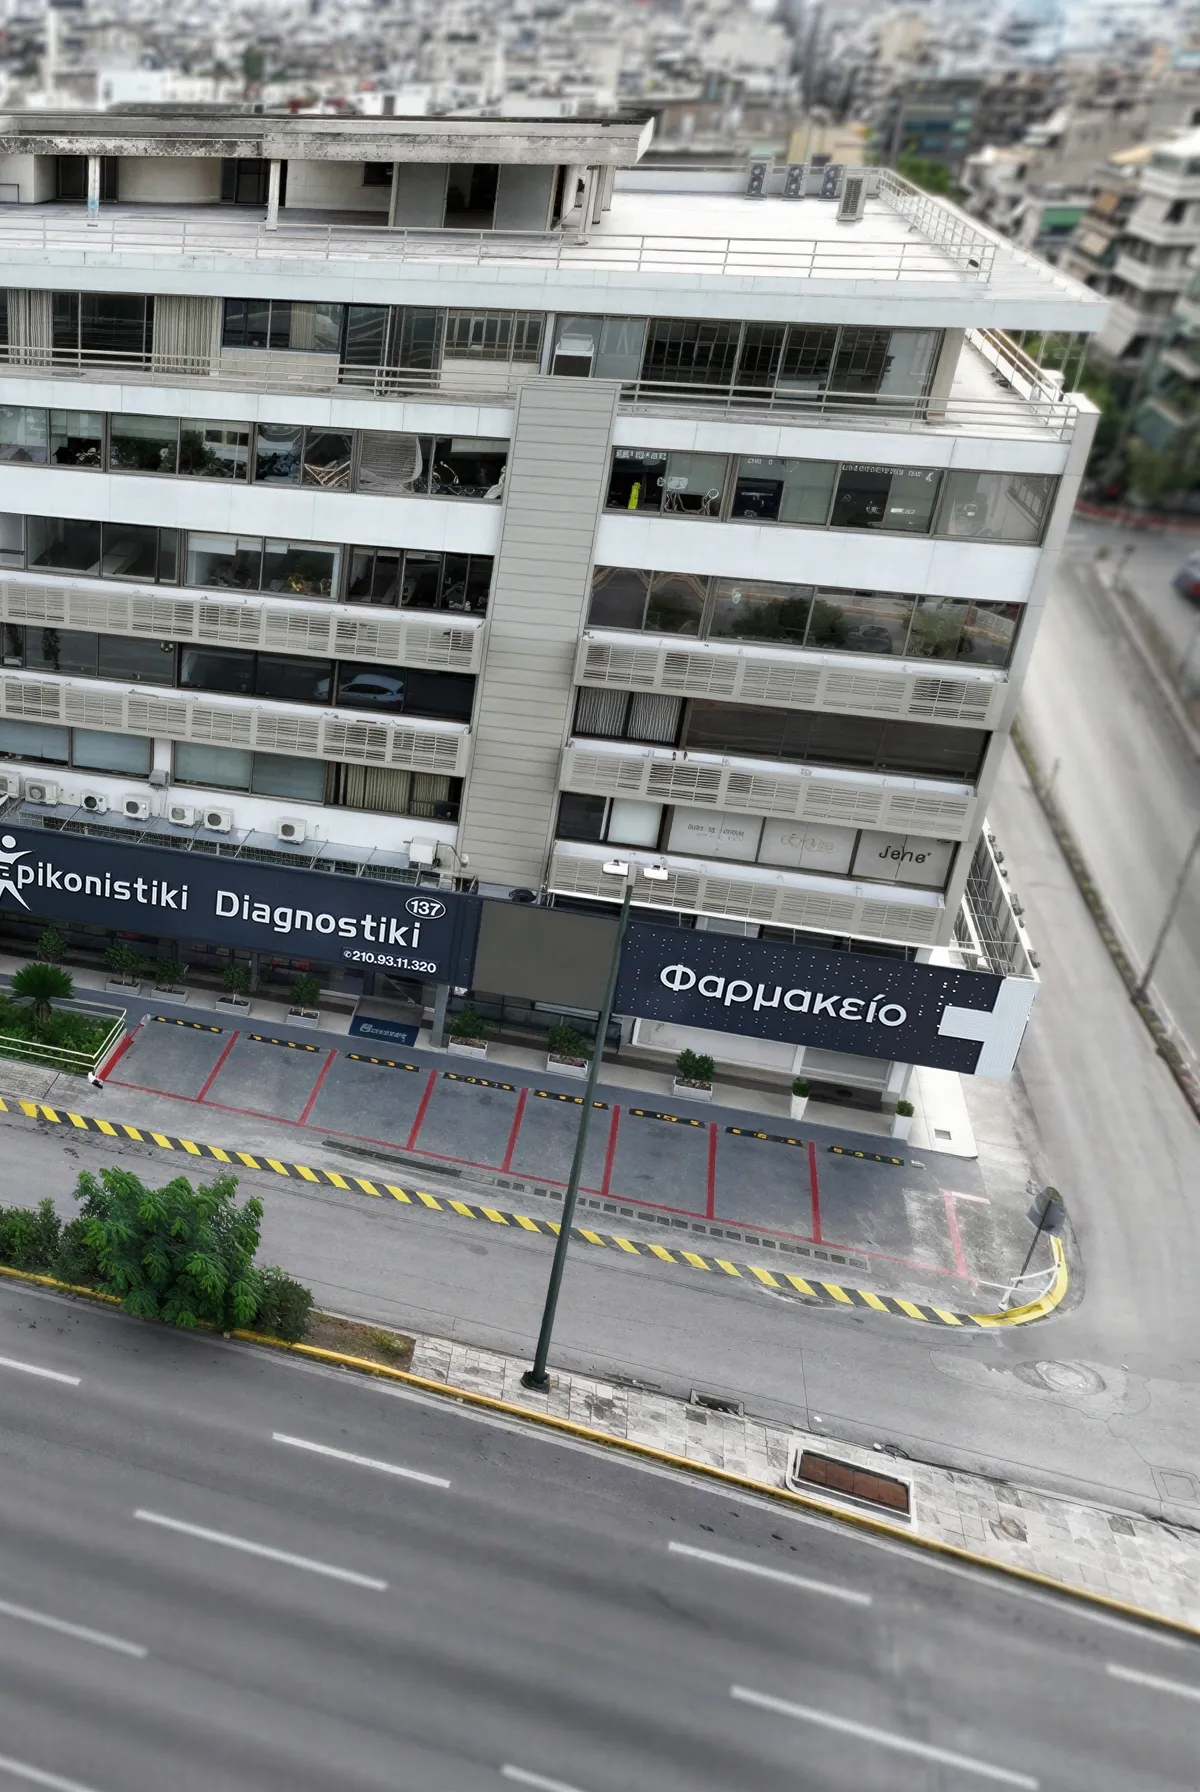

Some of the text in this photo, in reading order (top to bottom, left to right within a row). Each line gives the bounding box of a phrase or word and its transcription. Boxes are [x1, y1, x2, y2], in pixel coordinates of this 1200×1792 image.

[215, 890, 421, 948] Diagnostiki
[410, 900, 441, 917] 137
[352, 950, 437, 974] 210.93.11.320
[660, 964, 907, 1027] Φαρμακείο
